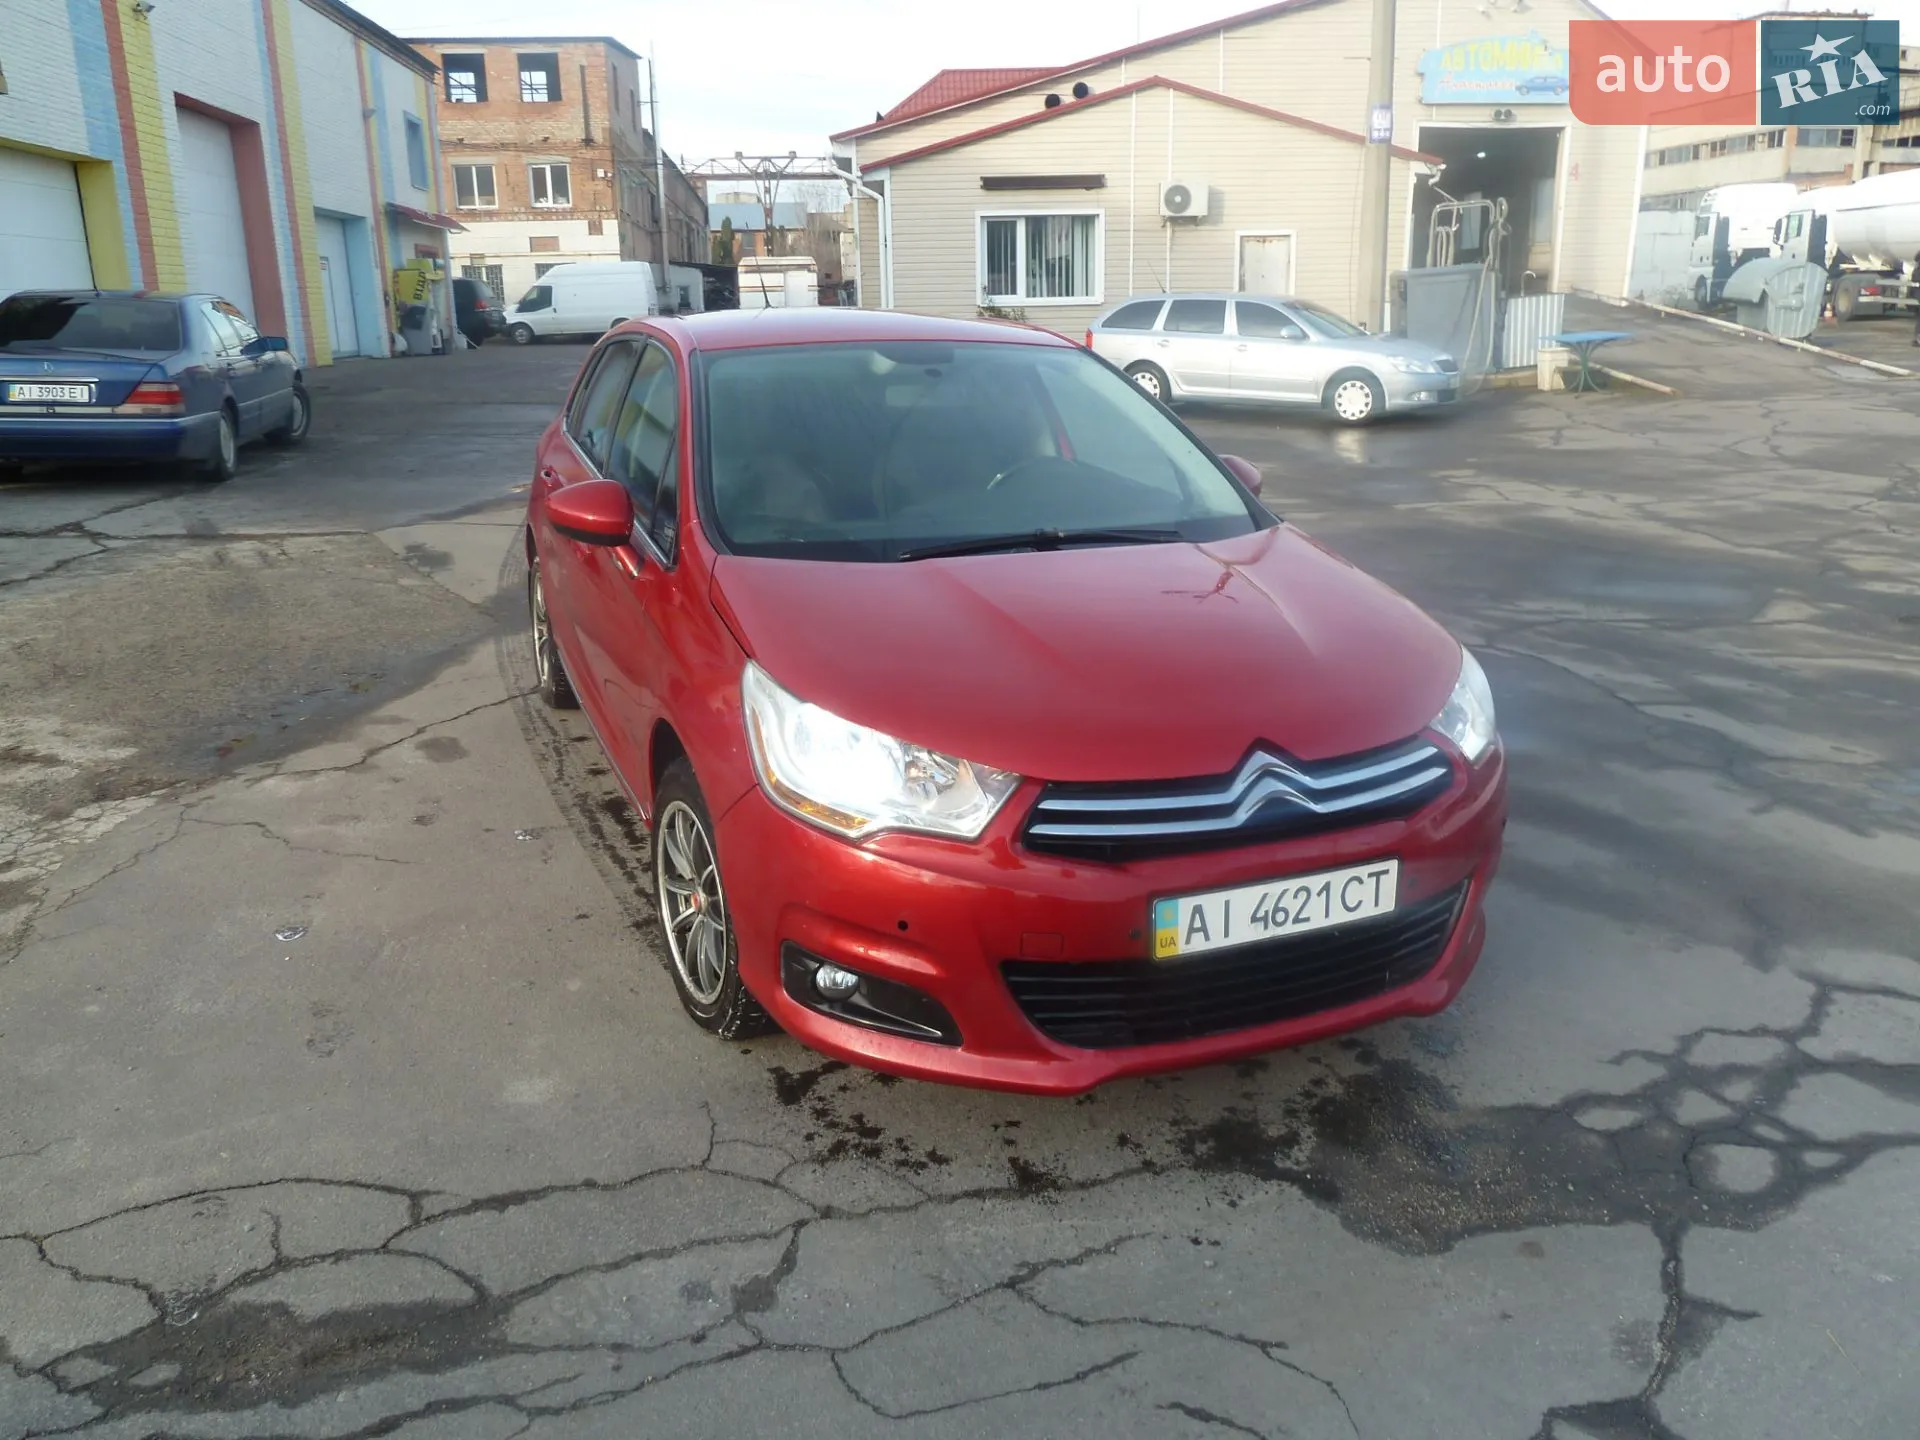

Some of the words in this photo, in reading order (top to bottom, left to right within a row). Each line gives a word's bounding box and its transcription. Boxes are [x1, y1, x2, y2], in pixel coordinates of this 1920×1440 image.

[37, 386, 66, 398] 3903
[1184, 899, 1231, 946] AI
[1249, 880, 1332, 932] 4621
[1339, 868, 1390, 914] CT
[1159, 935, 1177, 949] UA
